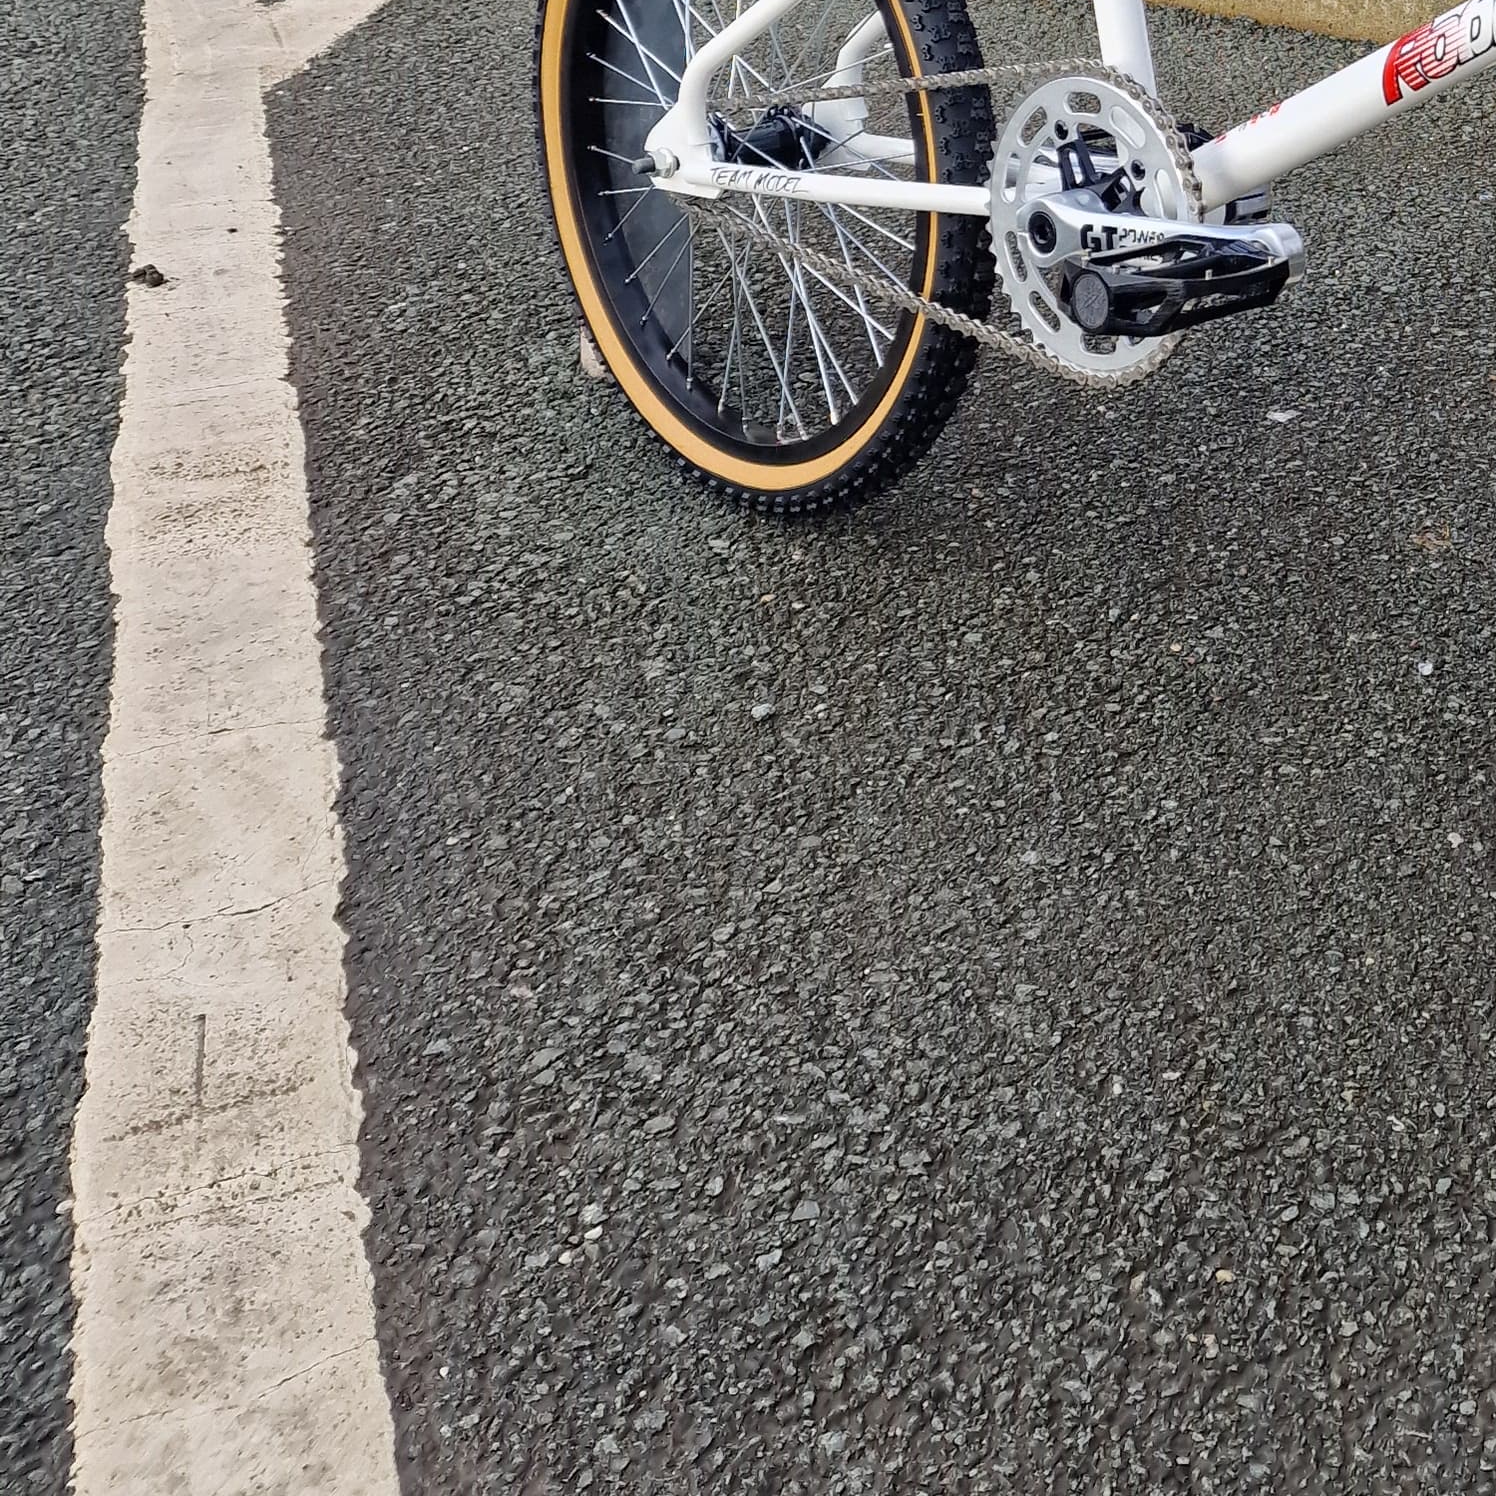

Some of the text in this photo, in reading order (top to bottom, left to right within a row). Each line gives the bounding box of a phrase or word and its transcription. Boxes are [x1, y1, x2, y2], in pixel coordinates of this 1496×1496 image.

[709, 167, 809, 194] TEAM MODEL
[1080, 224, 1118, 252] GT
